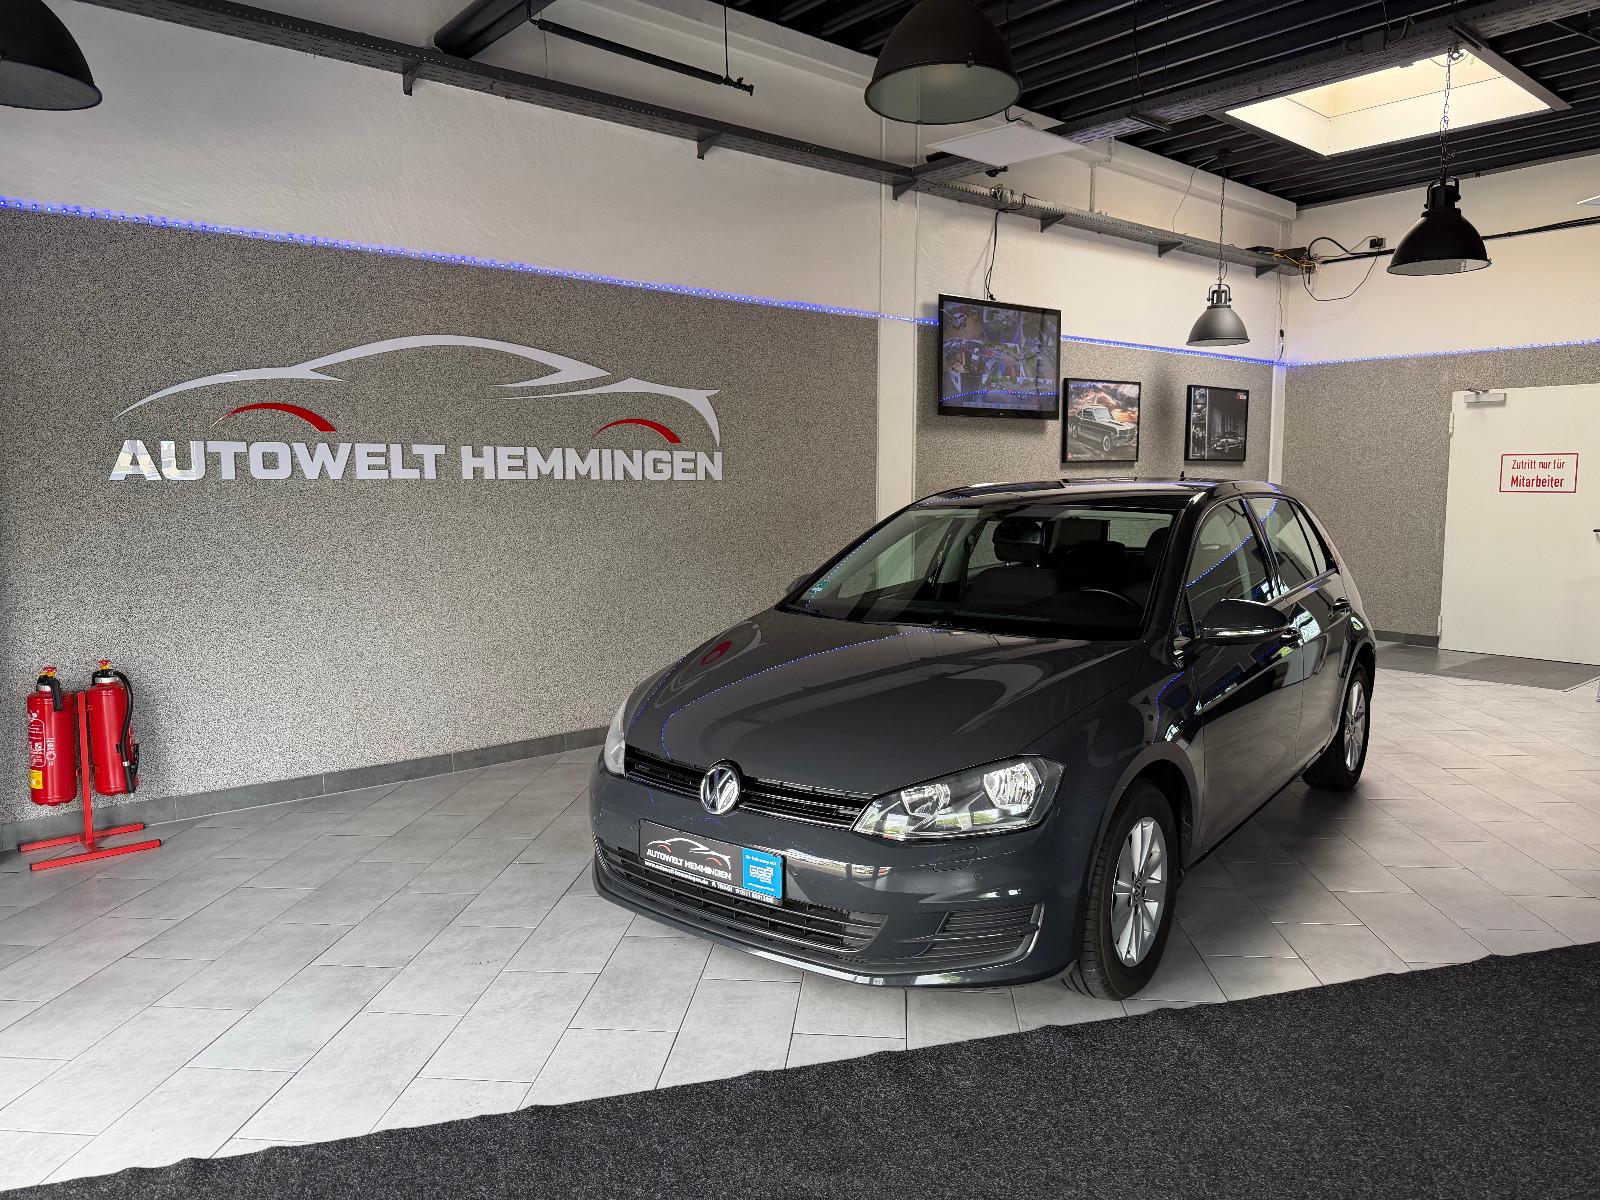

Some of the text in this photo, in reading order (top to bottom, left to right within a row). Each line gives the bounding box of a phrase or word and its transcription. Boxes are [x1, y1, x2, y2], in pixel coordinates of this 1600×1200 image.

[109, 439, 723, 481] AUTOWELT HEMMINGEN
[1511, 458, 1566, 470] Zutritt nur für
[1510, 474, 1565, 488] Mitarbeiter
[646, 848, 684, 866] AUTOWELT
[684, 859, 732, 881] HEMMINGEN
